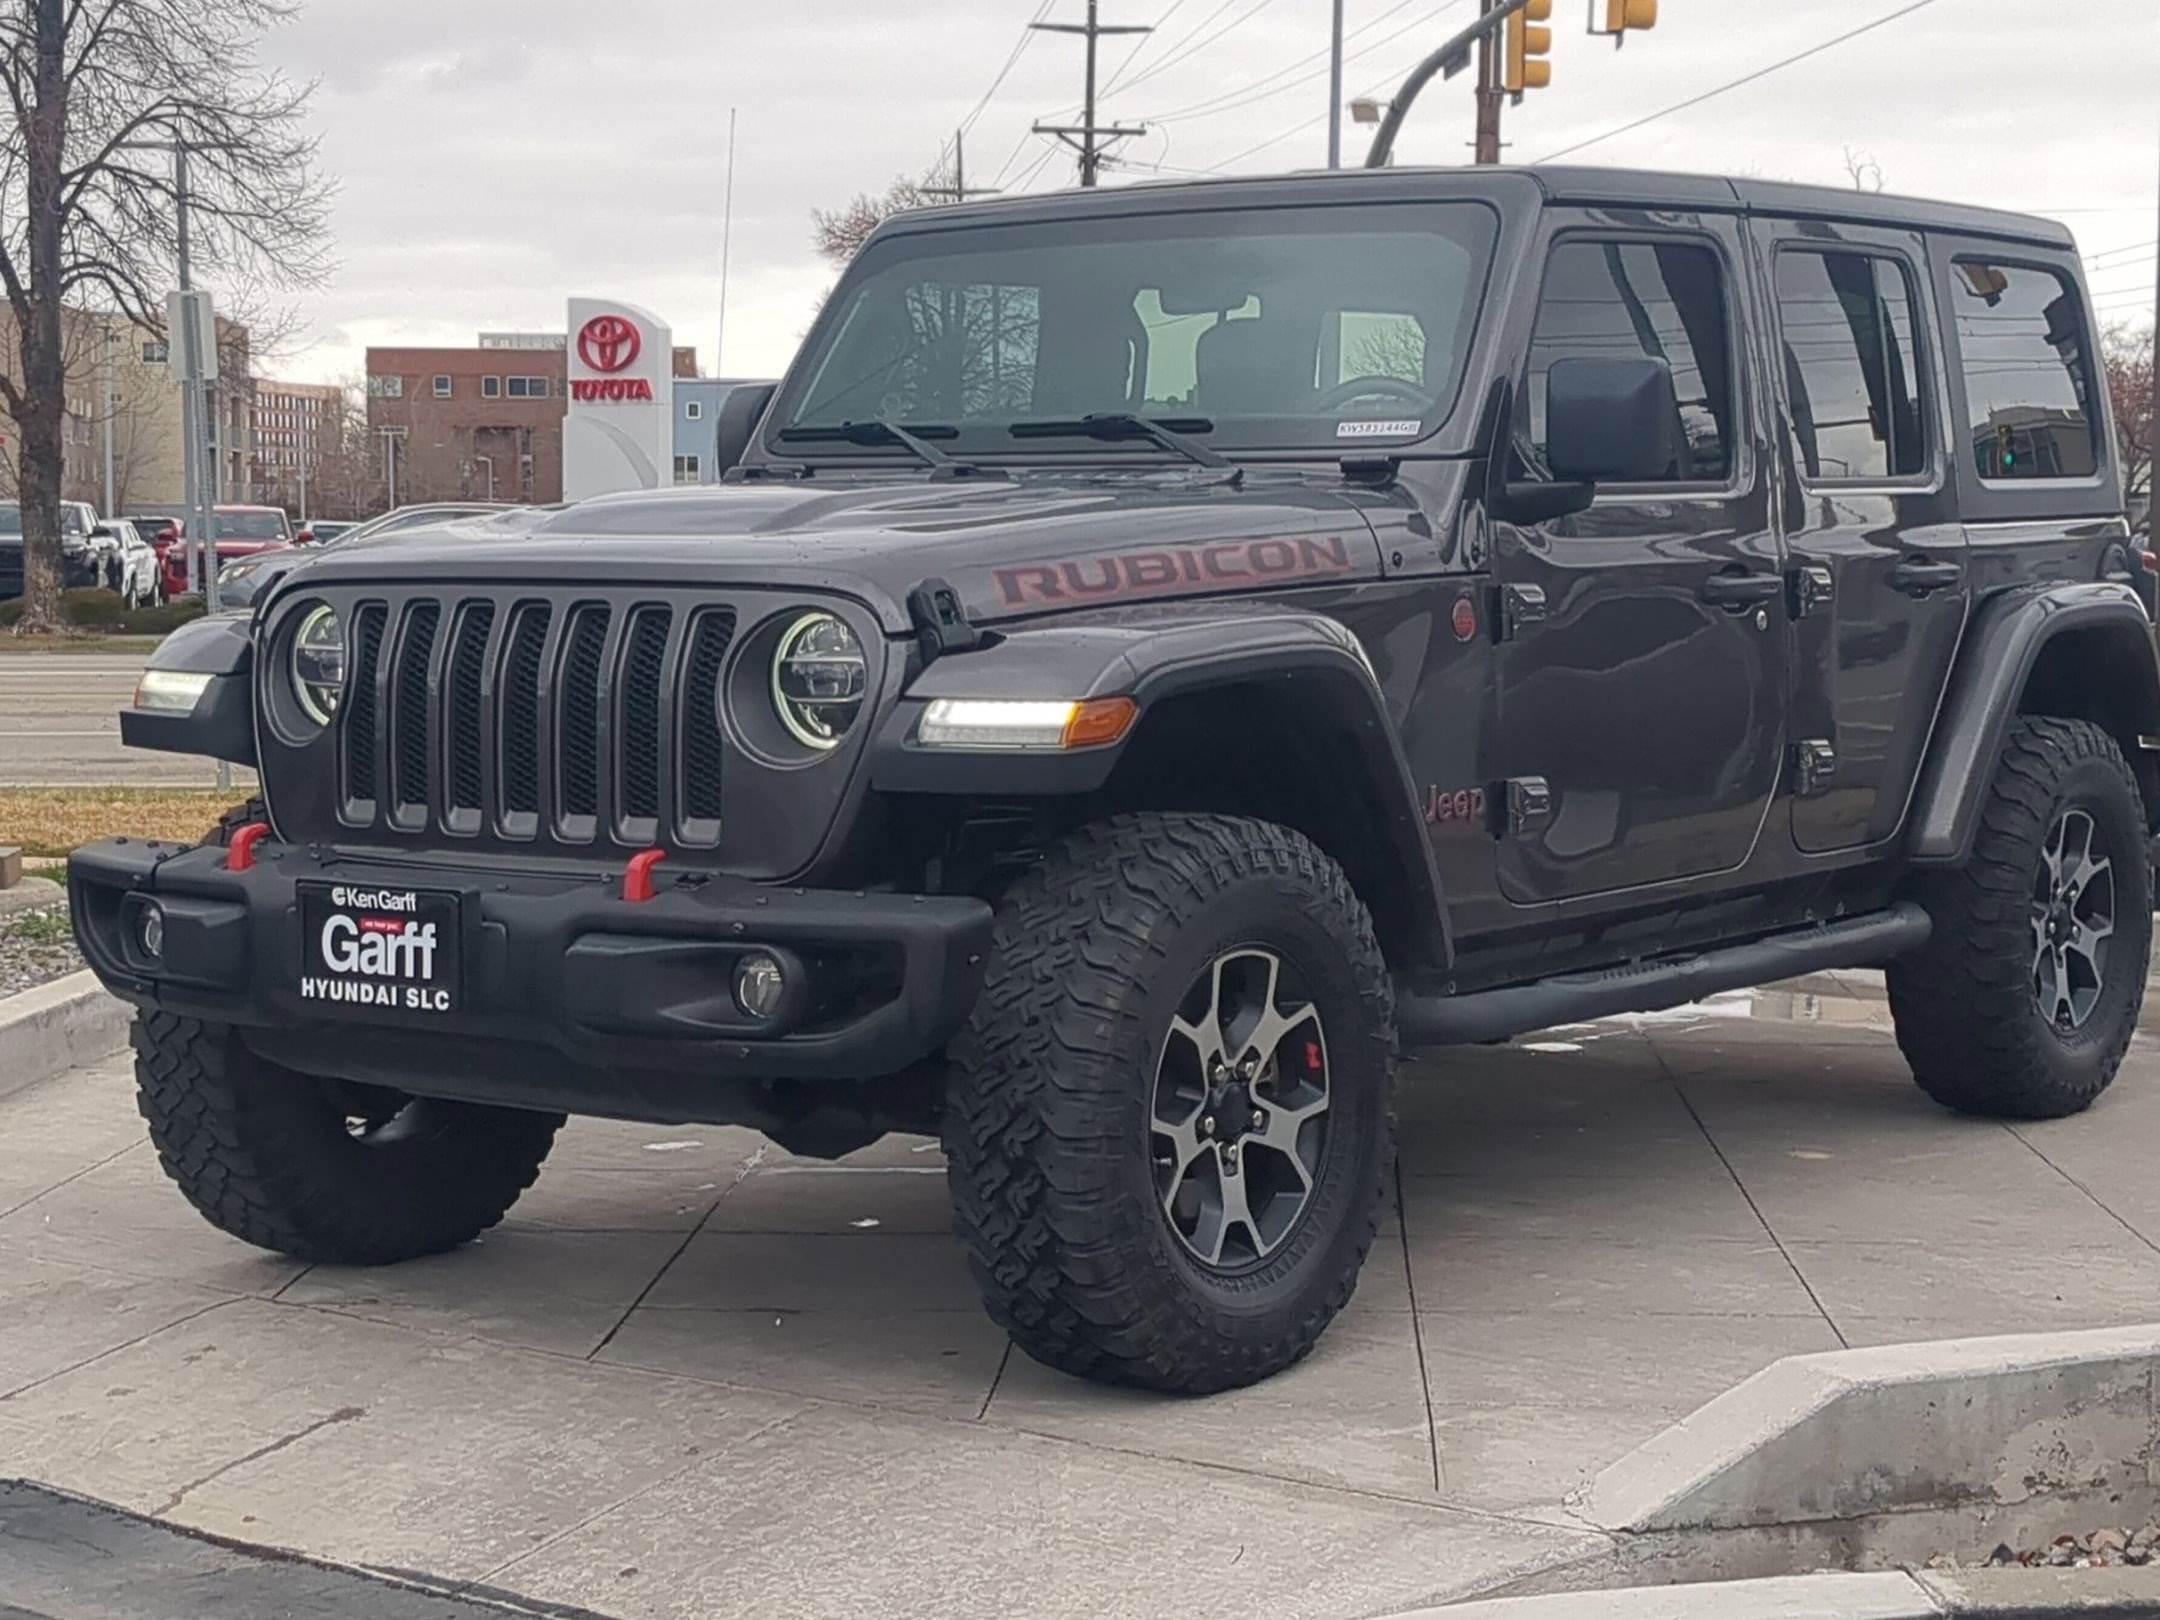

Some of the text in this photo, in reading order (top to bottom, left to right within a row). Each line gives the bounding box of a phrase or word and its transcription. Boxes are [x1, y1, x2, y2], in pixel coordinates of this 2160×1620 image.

[569, 378, 652, 401] TOYOTA
[993, 536, 1353, 609] RUBICON
[1423, 784, 1484, 824] Jeep
[321, 914, 437, 980] Garff
[301, 977, 450, 1010] HYUNDAI SLC
